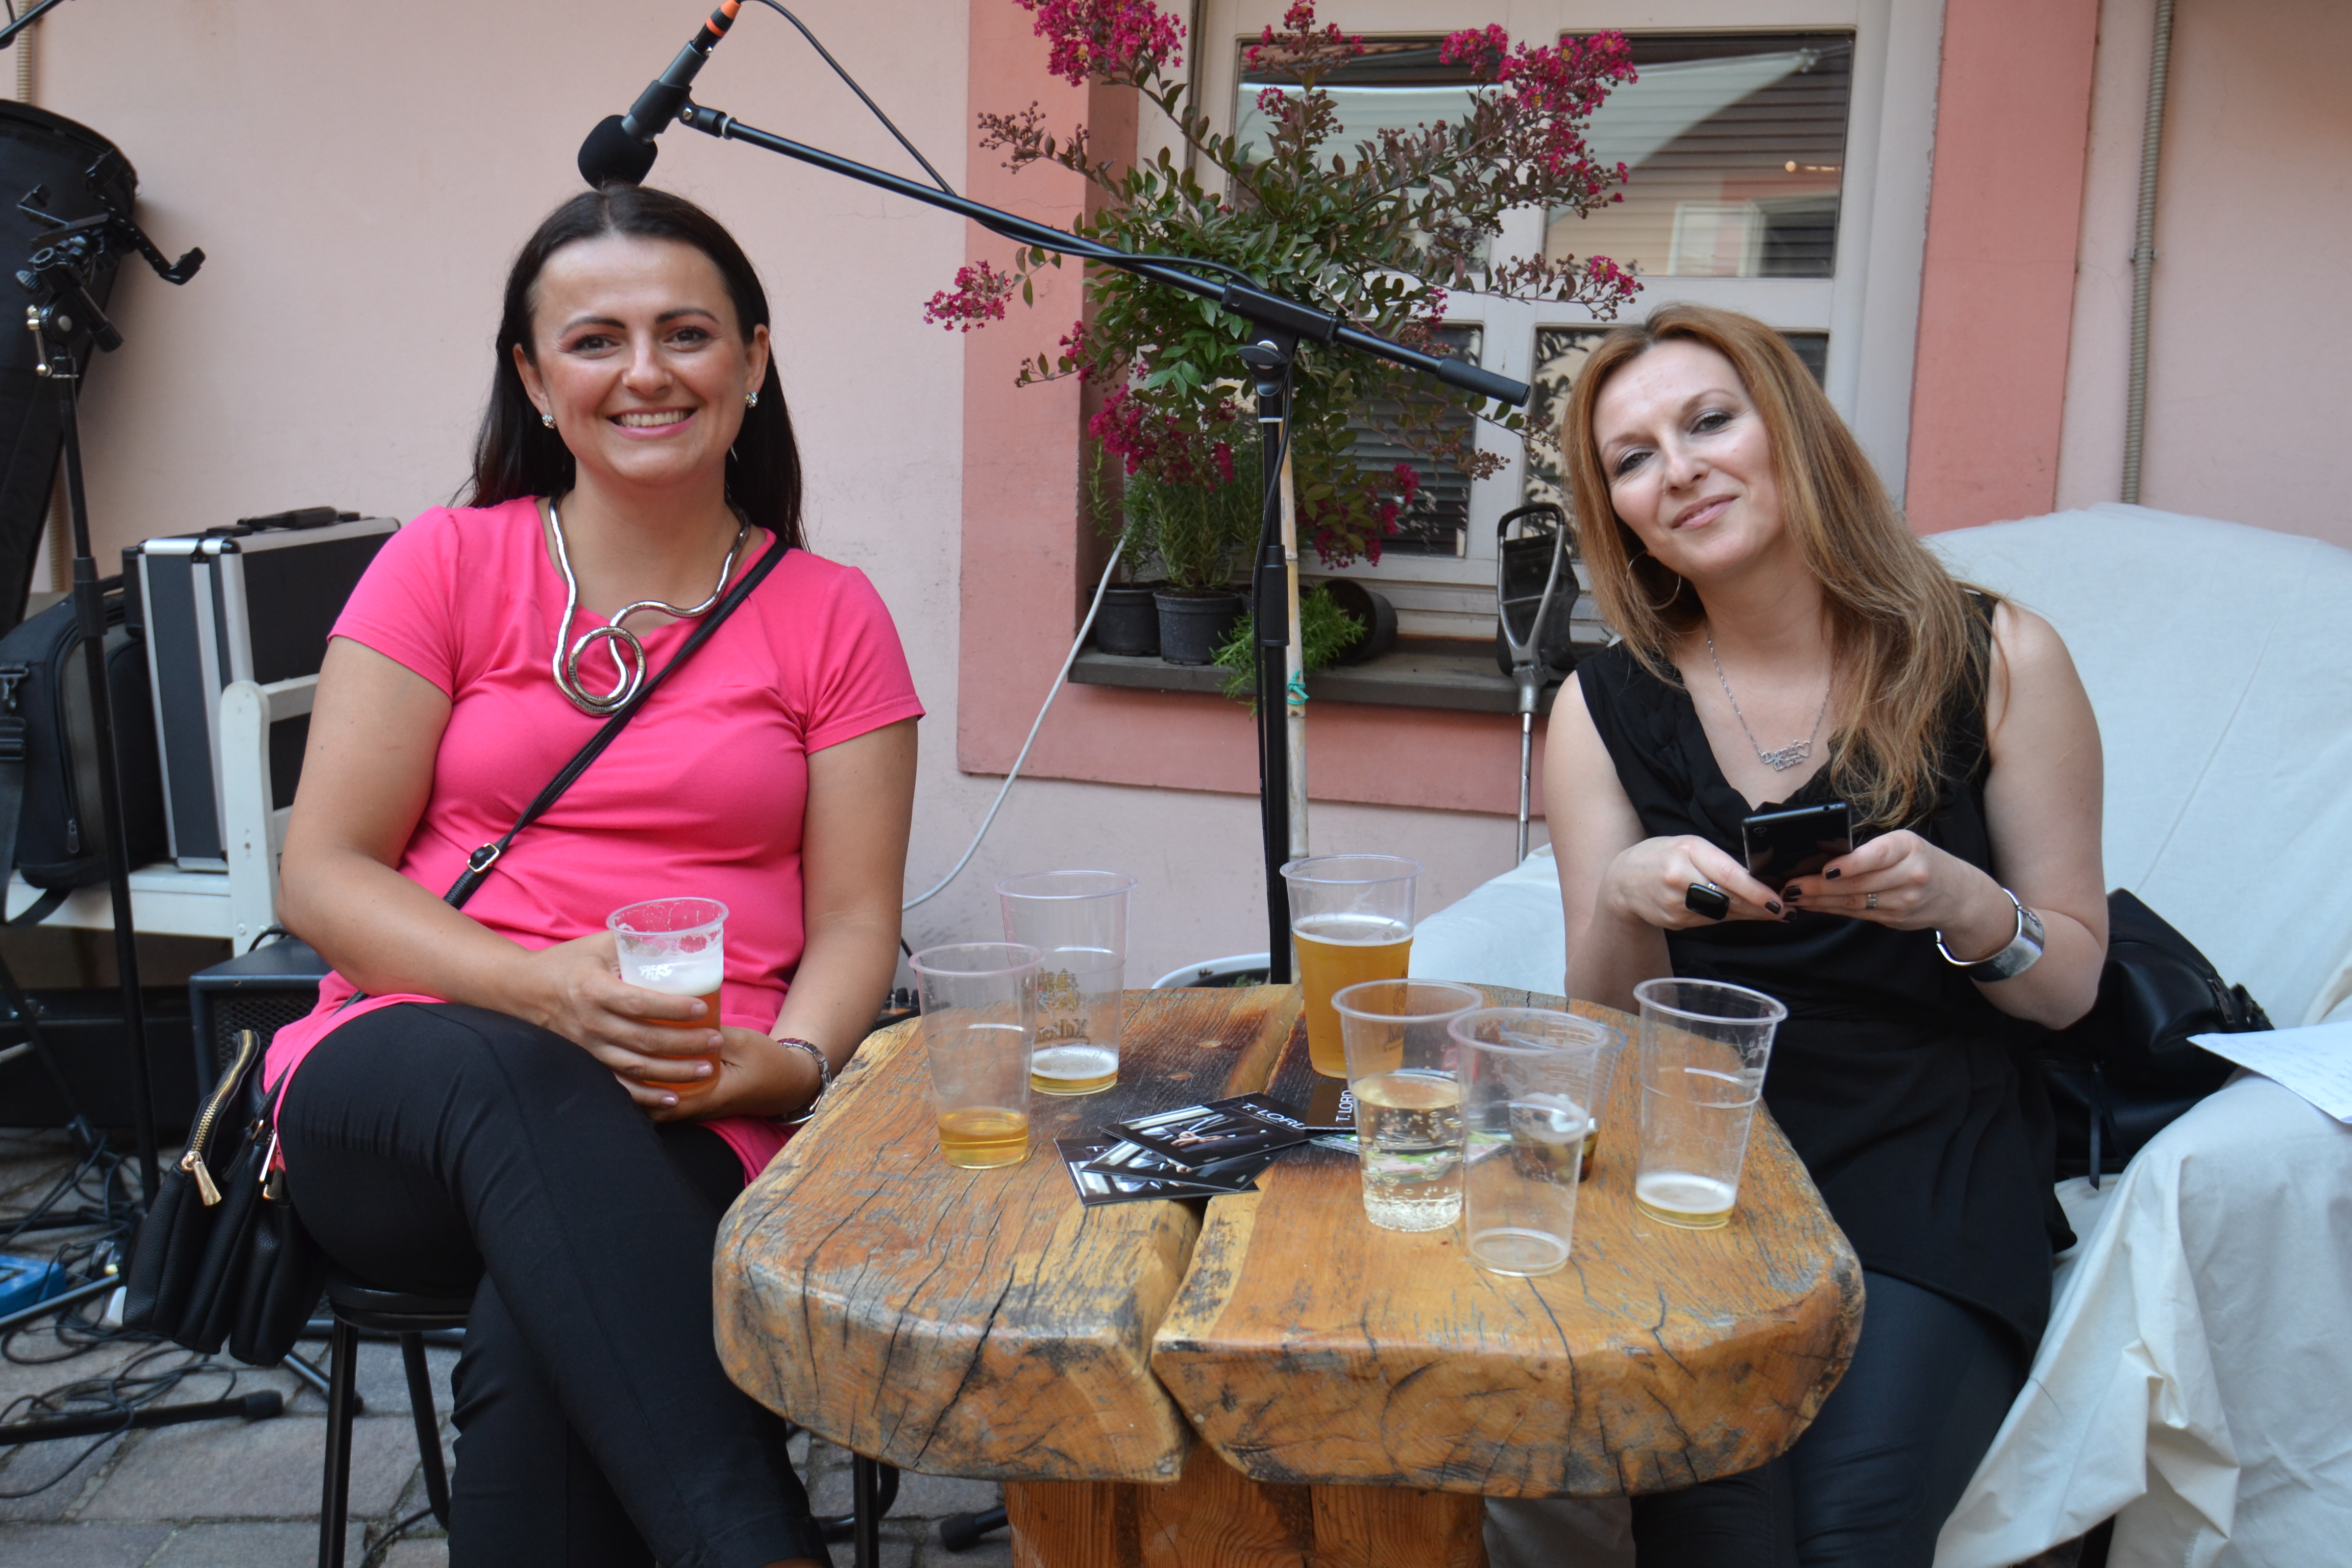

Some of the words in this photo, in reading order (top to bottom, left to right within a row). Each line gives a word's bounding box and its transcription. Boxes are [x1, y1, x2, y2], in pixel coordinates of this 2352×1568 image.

[1337, 1090, 1354, 1113] LORD
[1242, 1102, 1258, 1111] T.
[1256, 1109, 1305, 1130] LORD
